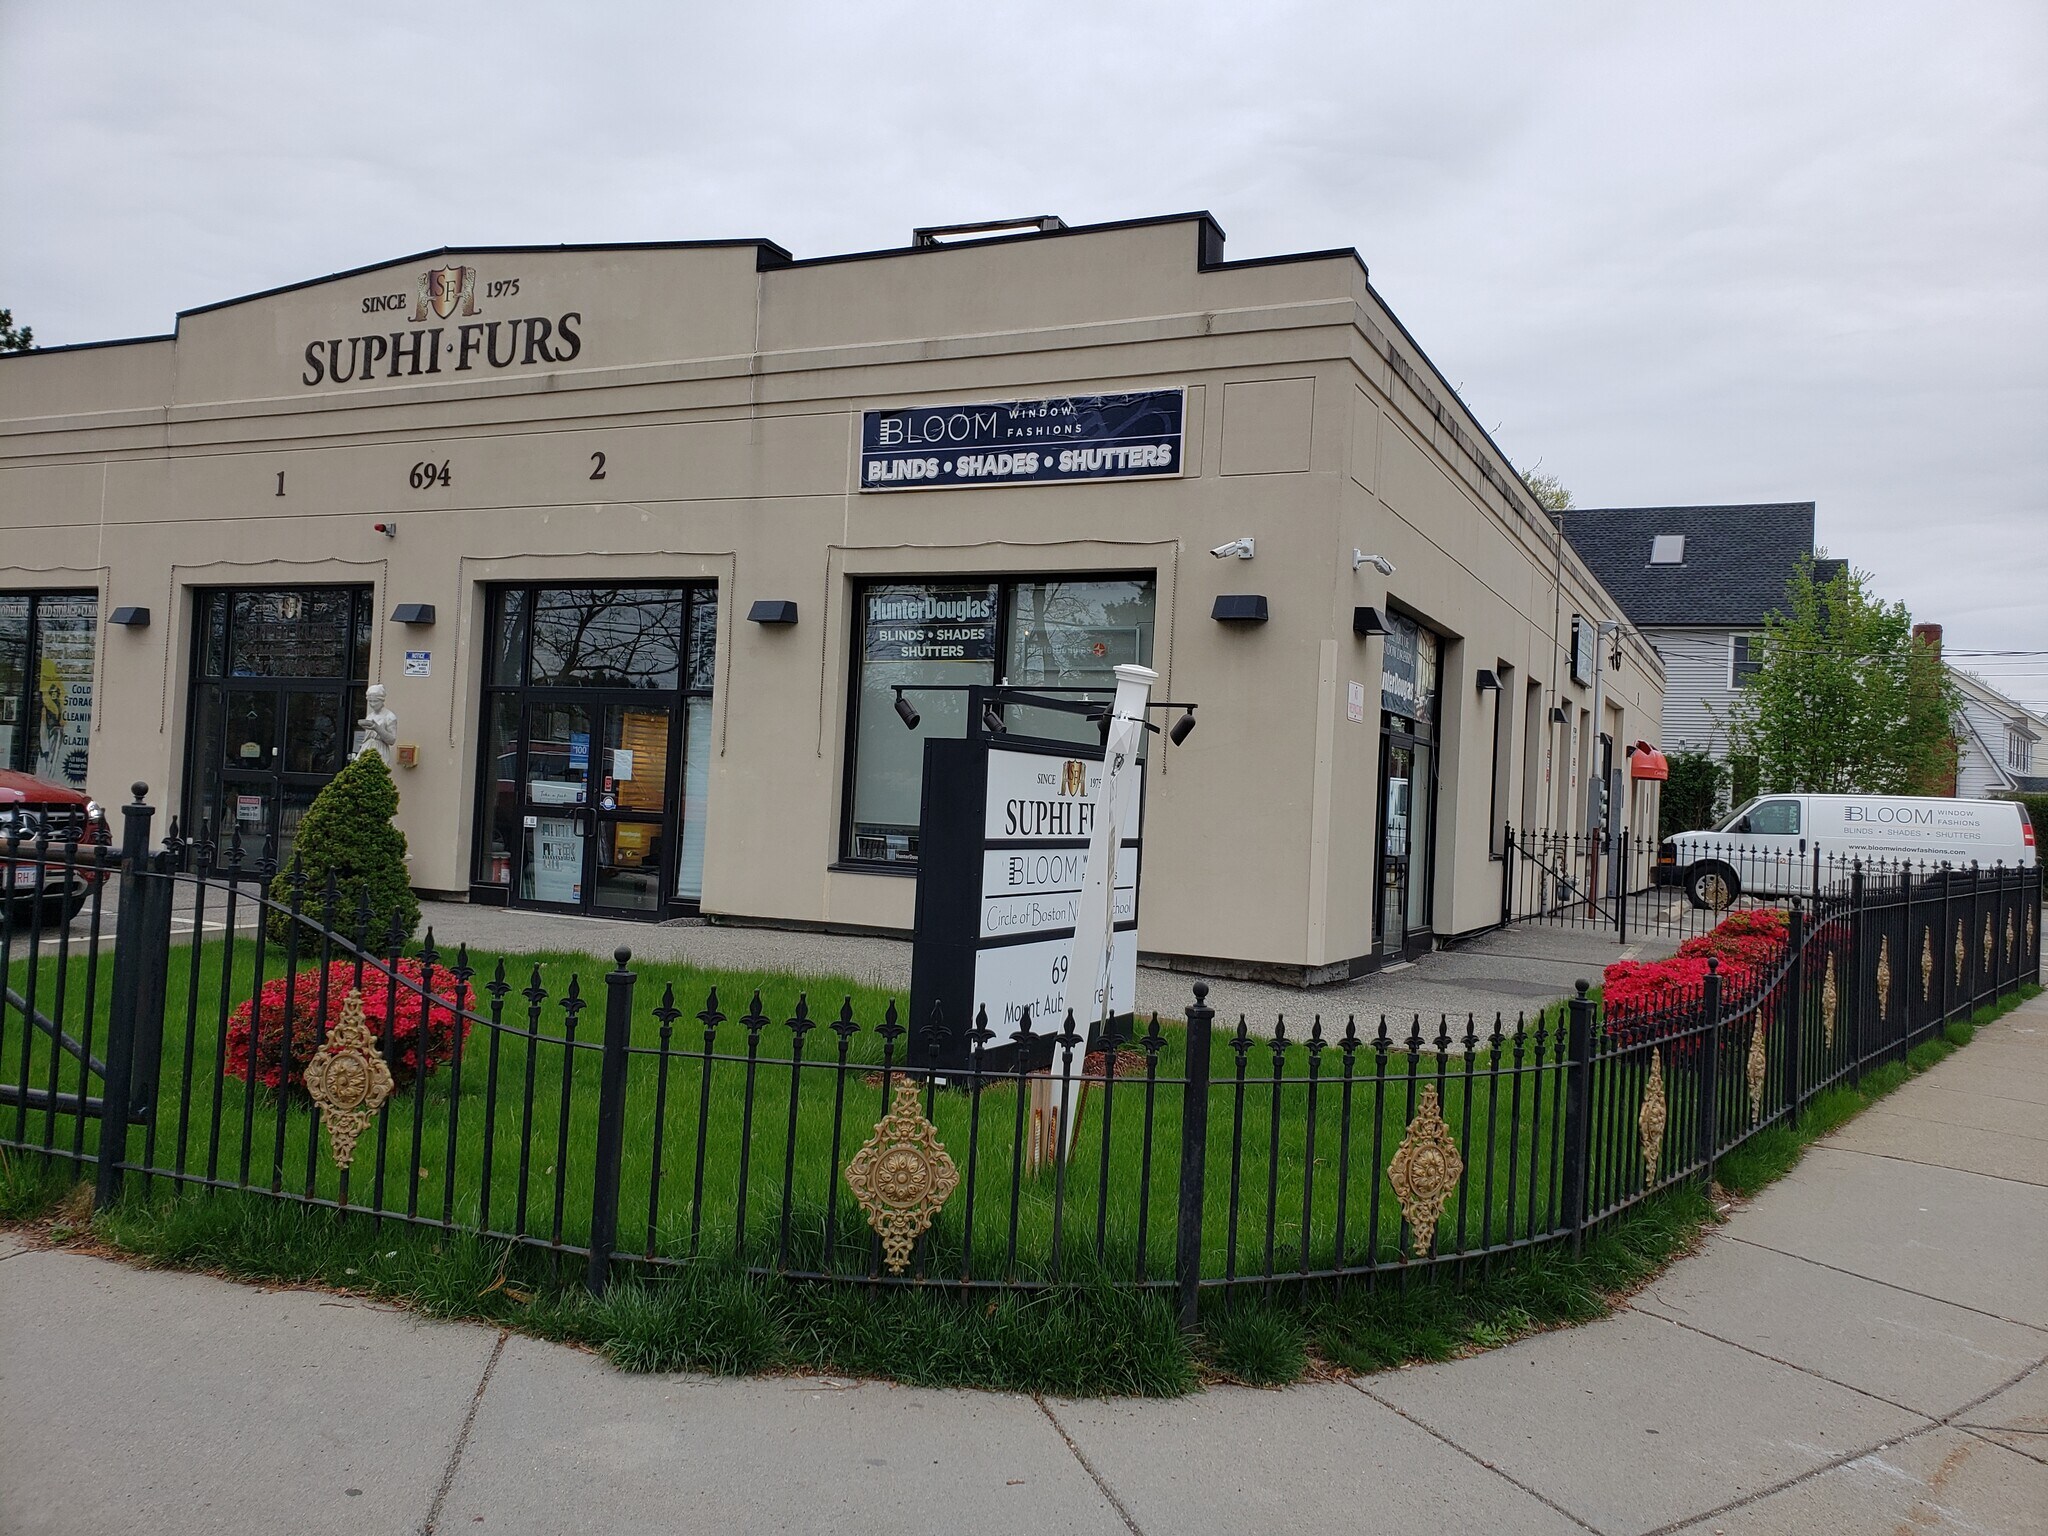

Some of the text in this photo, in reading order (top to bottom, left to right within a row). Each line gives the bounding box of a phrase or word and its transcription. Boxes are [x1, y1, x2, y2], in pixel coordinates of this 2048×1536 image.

[361, 279, 520, 313] SINCE 1975
[302, 312, 582, 386] SUPHI FURS
[1009, 407, 1072, 420] WINDOW
[880, 412, 997, 445] BLOOM
[1007, 424, 1082, 438] FASHIONS
[589, 451, 607, 481] 2
[868, 443, 1172, 482] BLINDS SHADES SHUTTERS
[275, 470, 286, 496] 1
[409, 460, 452, 489] 694
[869, 596, 990, 622] HunterDouglas
[879, 629, 985, 641] BLINDS SHADES
[901, 645, 965, 657] SHUTTERS
[72, 684, 91, 694] COLD
[63, 696, 93, 707] STORAG
[62, 711, 91, 722] CLEANIN
[62, 735, 88, 746] GLAZIN
[1036, 773, 1102, 789] SINCE 1975
[1005, 798, 1073, 835] SUPHI
[1844, 806, 1933, 825] BLOOM
[1938, 809, 1974, 817] WINDOW
[1937, 819, 1981, 827] FASHIONS
[1843, 827, 1981, 840] BLINDS SHADES SHUTTERS
[1848, 844, 1966, 856] www.bloomwindowfashions.com
[1008, 855, 1078, 886] BLOOM
[986, 904, 1017, 931] Circle
[1019, 902, 1031, 924] of
[1032, 902, 1066, 927] Boston
[1113, 894, 1131, 916] chool
[1051, 955, 1069, 985] 69
[1043, 991, 1064, 1016] Aub
